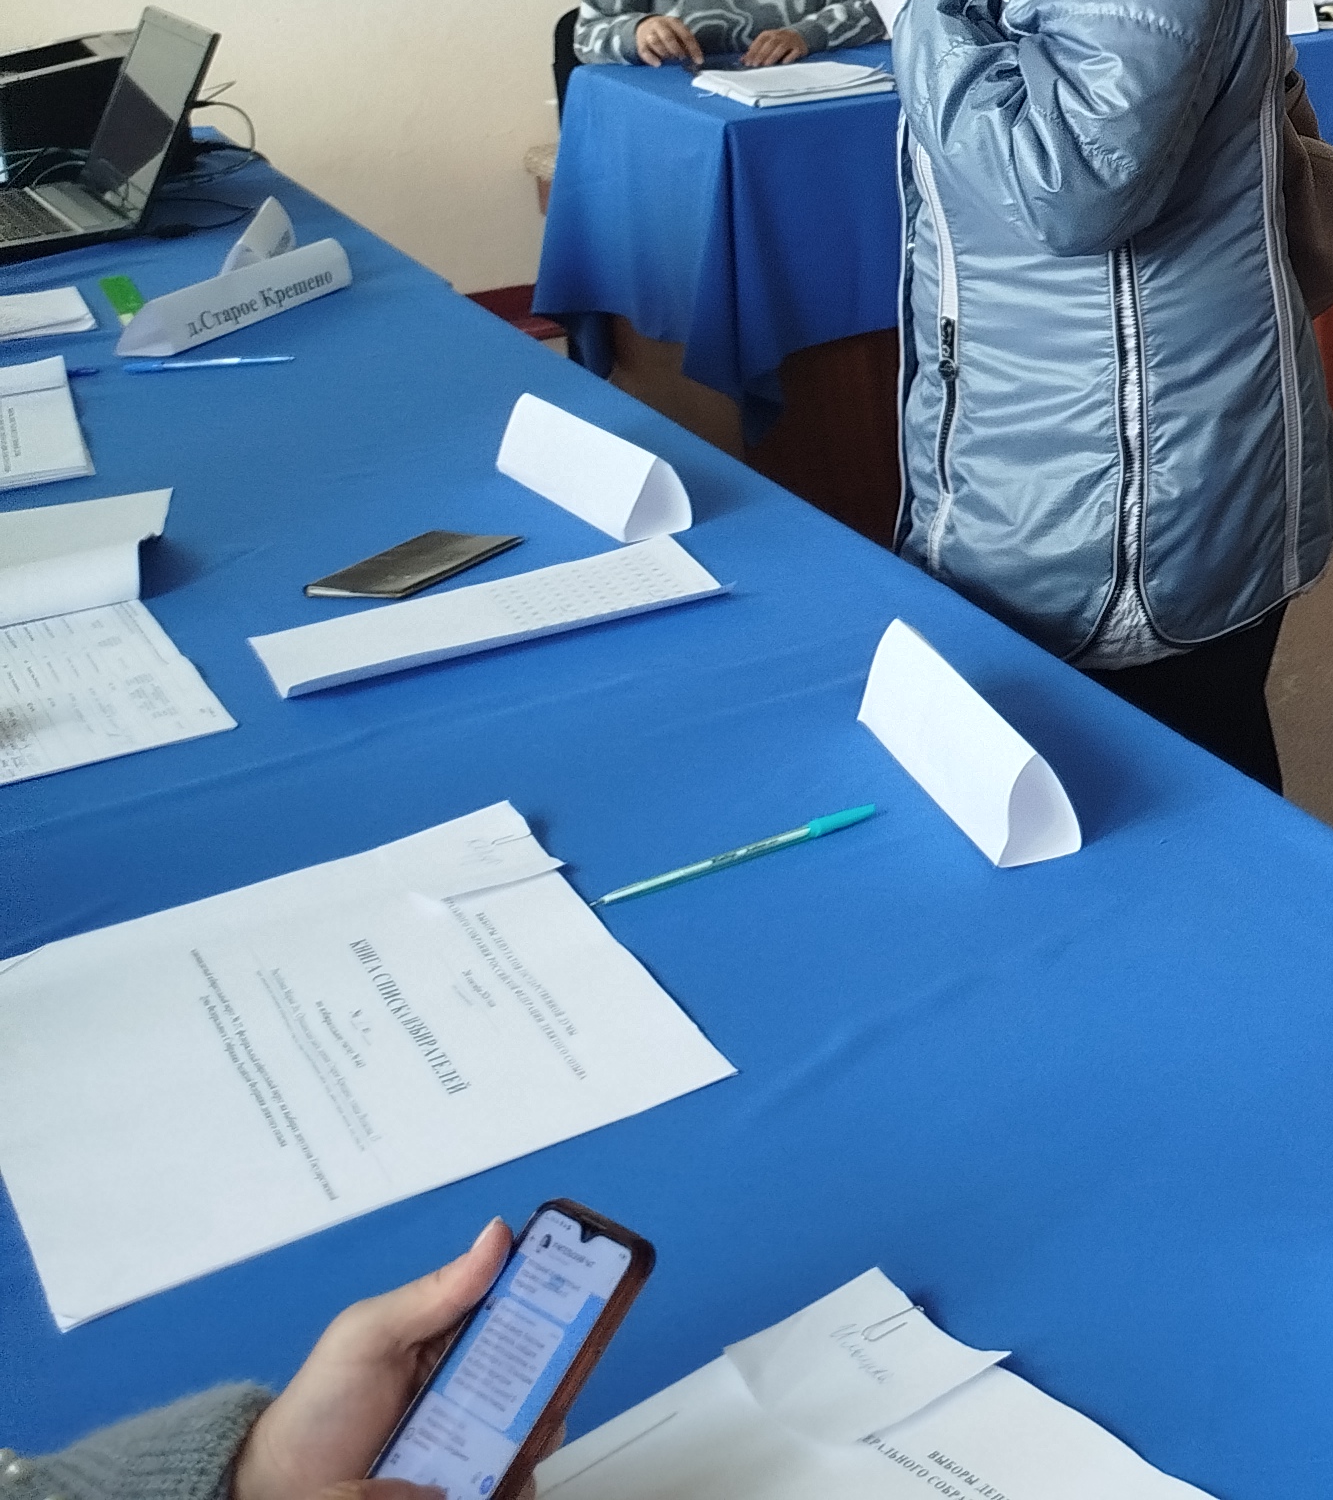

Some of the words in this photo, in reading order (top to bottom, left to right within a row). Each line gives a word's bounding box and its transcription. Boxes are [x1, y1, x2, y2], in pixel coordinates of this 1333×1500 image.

[186, 298, 258, 337] д.Старое
[259, 271, 333, 308] Крешено
[350, 938, 383, 973] КНИГА
[371, 972, 413, 1019] СПИСКА
[400, 1015, 471, 1095] ИЗБИРАТЕЛЕЙ
[857, 1434, 929, 1478] ЕРАЛЬНОГО
[927, 1450, 980, 1486] ВЫБОРЫ
[975, 1483, 1012, 1500] ДЕП
